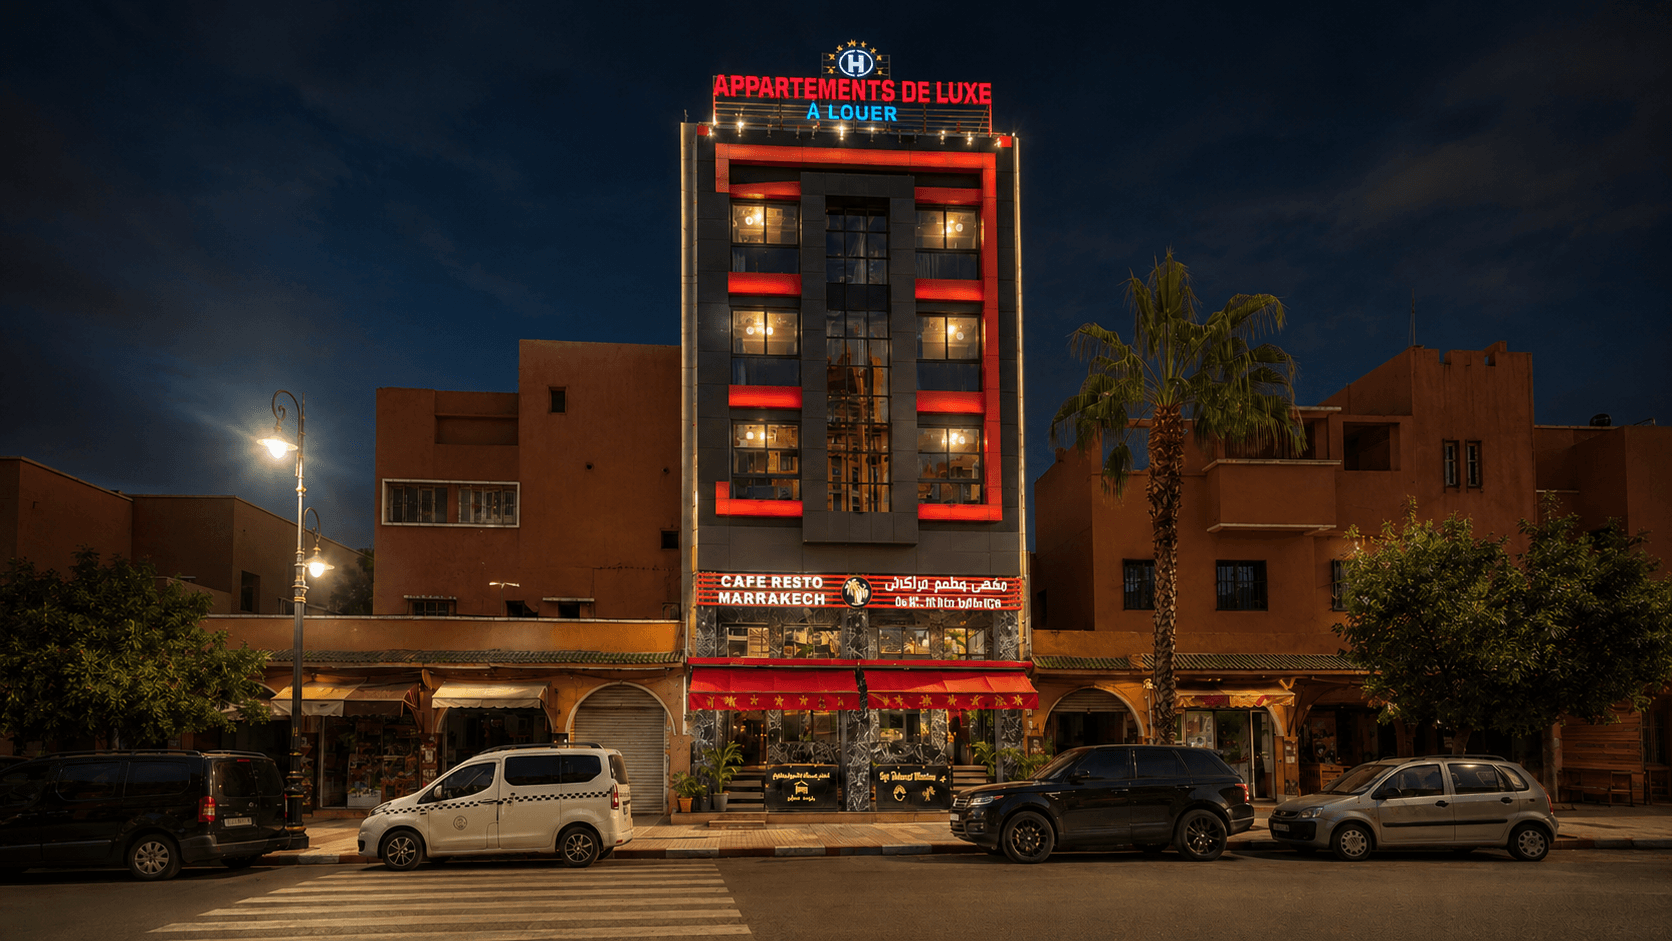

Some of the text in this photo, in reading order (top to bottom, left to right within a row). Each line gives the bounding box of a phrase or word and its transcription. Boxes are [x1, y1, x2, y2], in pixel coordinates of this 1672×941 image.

[847, 54, 865, 73] H
[713, 74, 992, 105] APPARTEMENTS DE LUXE
[828, 103, 898, 122] LOUER
[720, 575, 824, 589] CAFE RESTO
[718, 591, 826, 606] MARRAKECH
